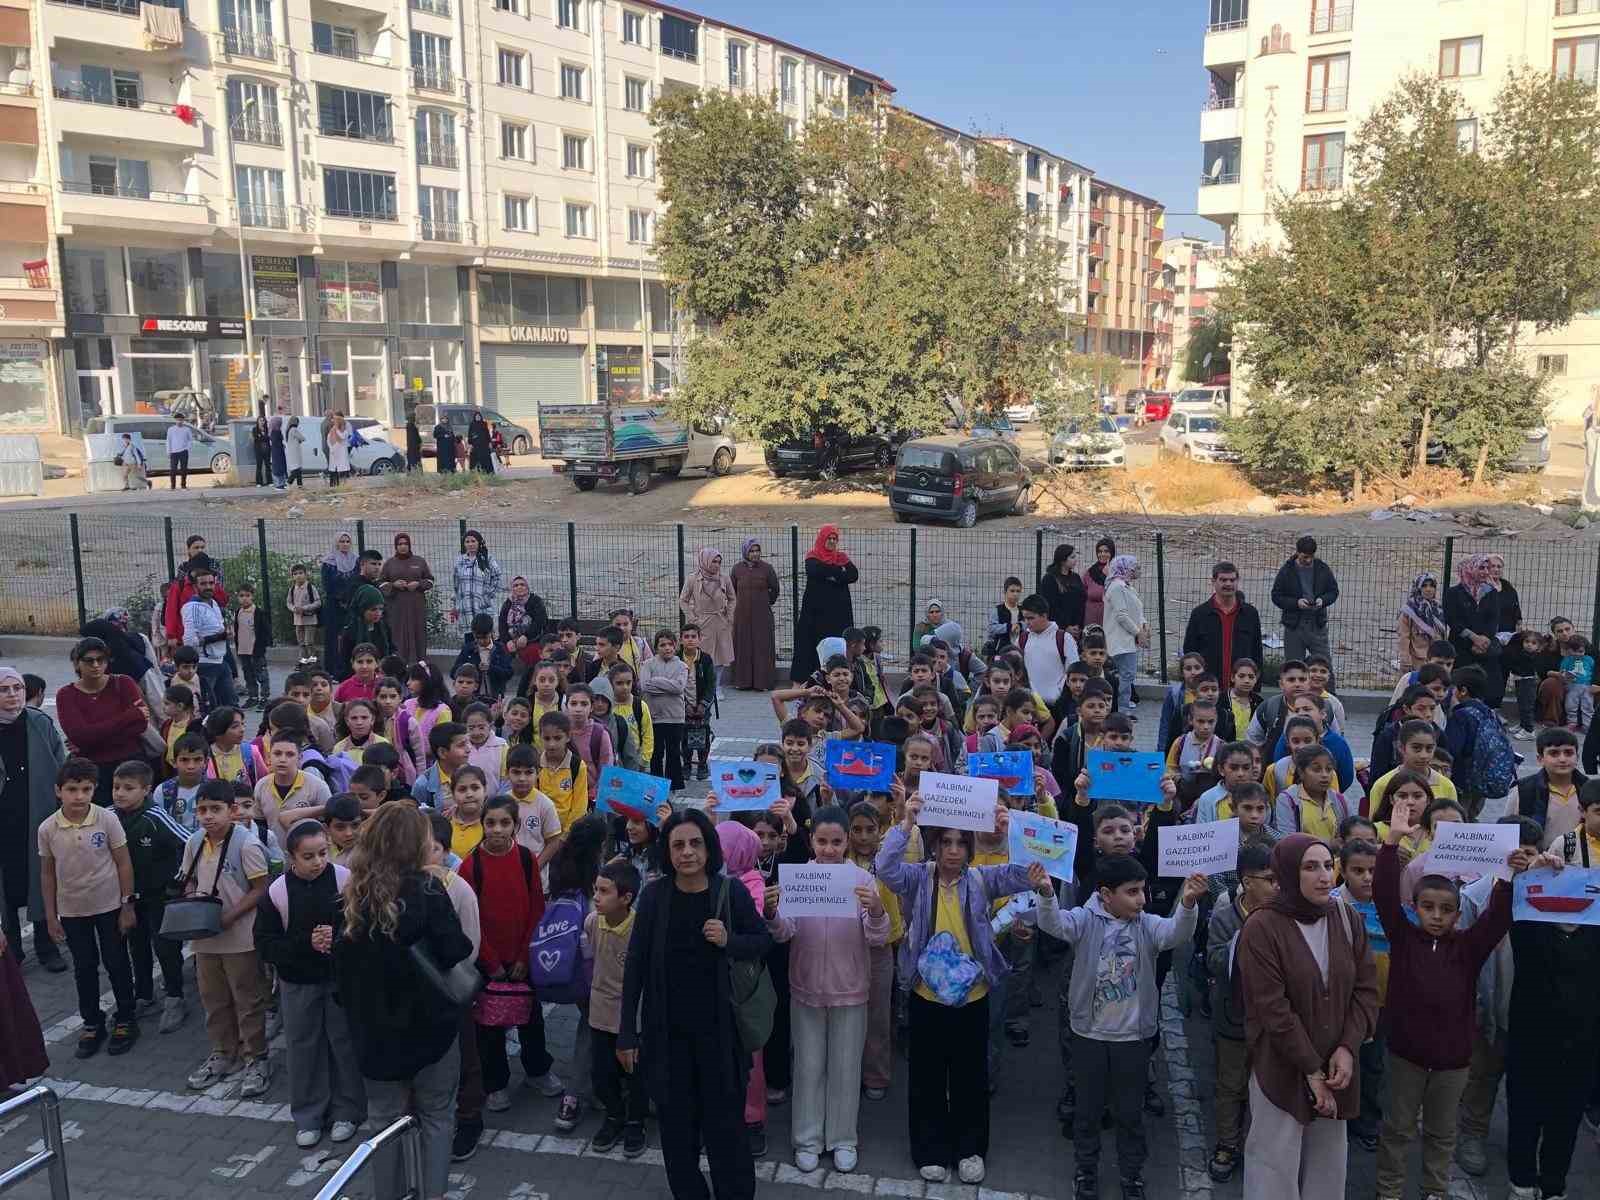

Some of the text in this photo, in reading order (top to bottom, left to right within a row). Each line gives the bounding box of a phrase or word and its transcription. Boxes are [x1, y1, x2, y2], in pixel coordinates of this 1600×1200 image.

[936, 782, 973, 792] KALBİMİZ
[925, 793, 967, 805] GAZZEDEKİ
[1176, 830, 1215, 840] KALBİMİZ
[1454, 831, 1496, 841] KALBİMİZ
[1165, 845, 1210, 855] GAZZEDEKİ
[1438, 844, 1487, 854] GAZZEDEKİ
[795, 872, 832, 880] KALBİMİZ
[784, 884, 827, 892] GAZZEDEKİ
[785, 896, 848, 904] KARDEŞLERİMİZLE
